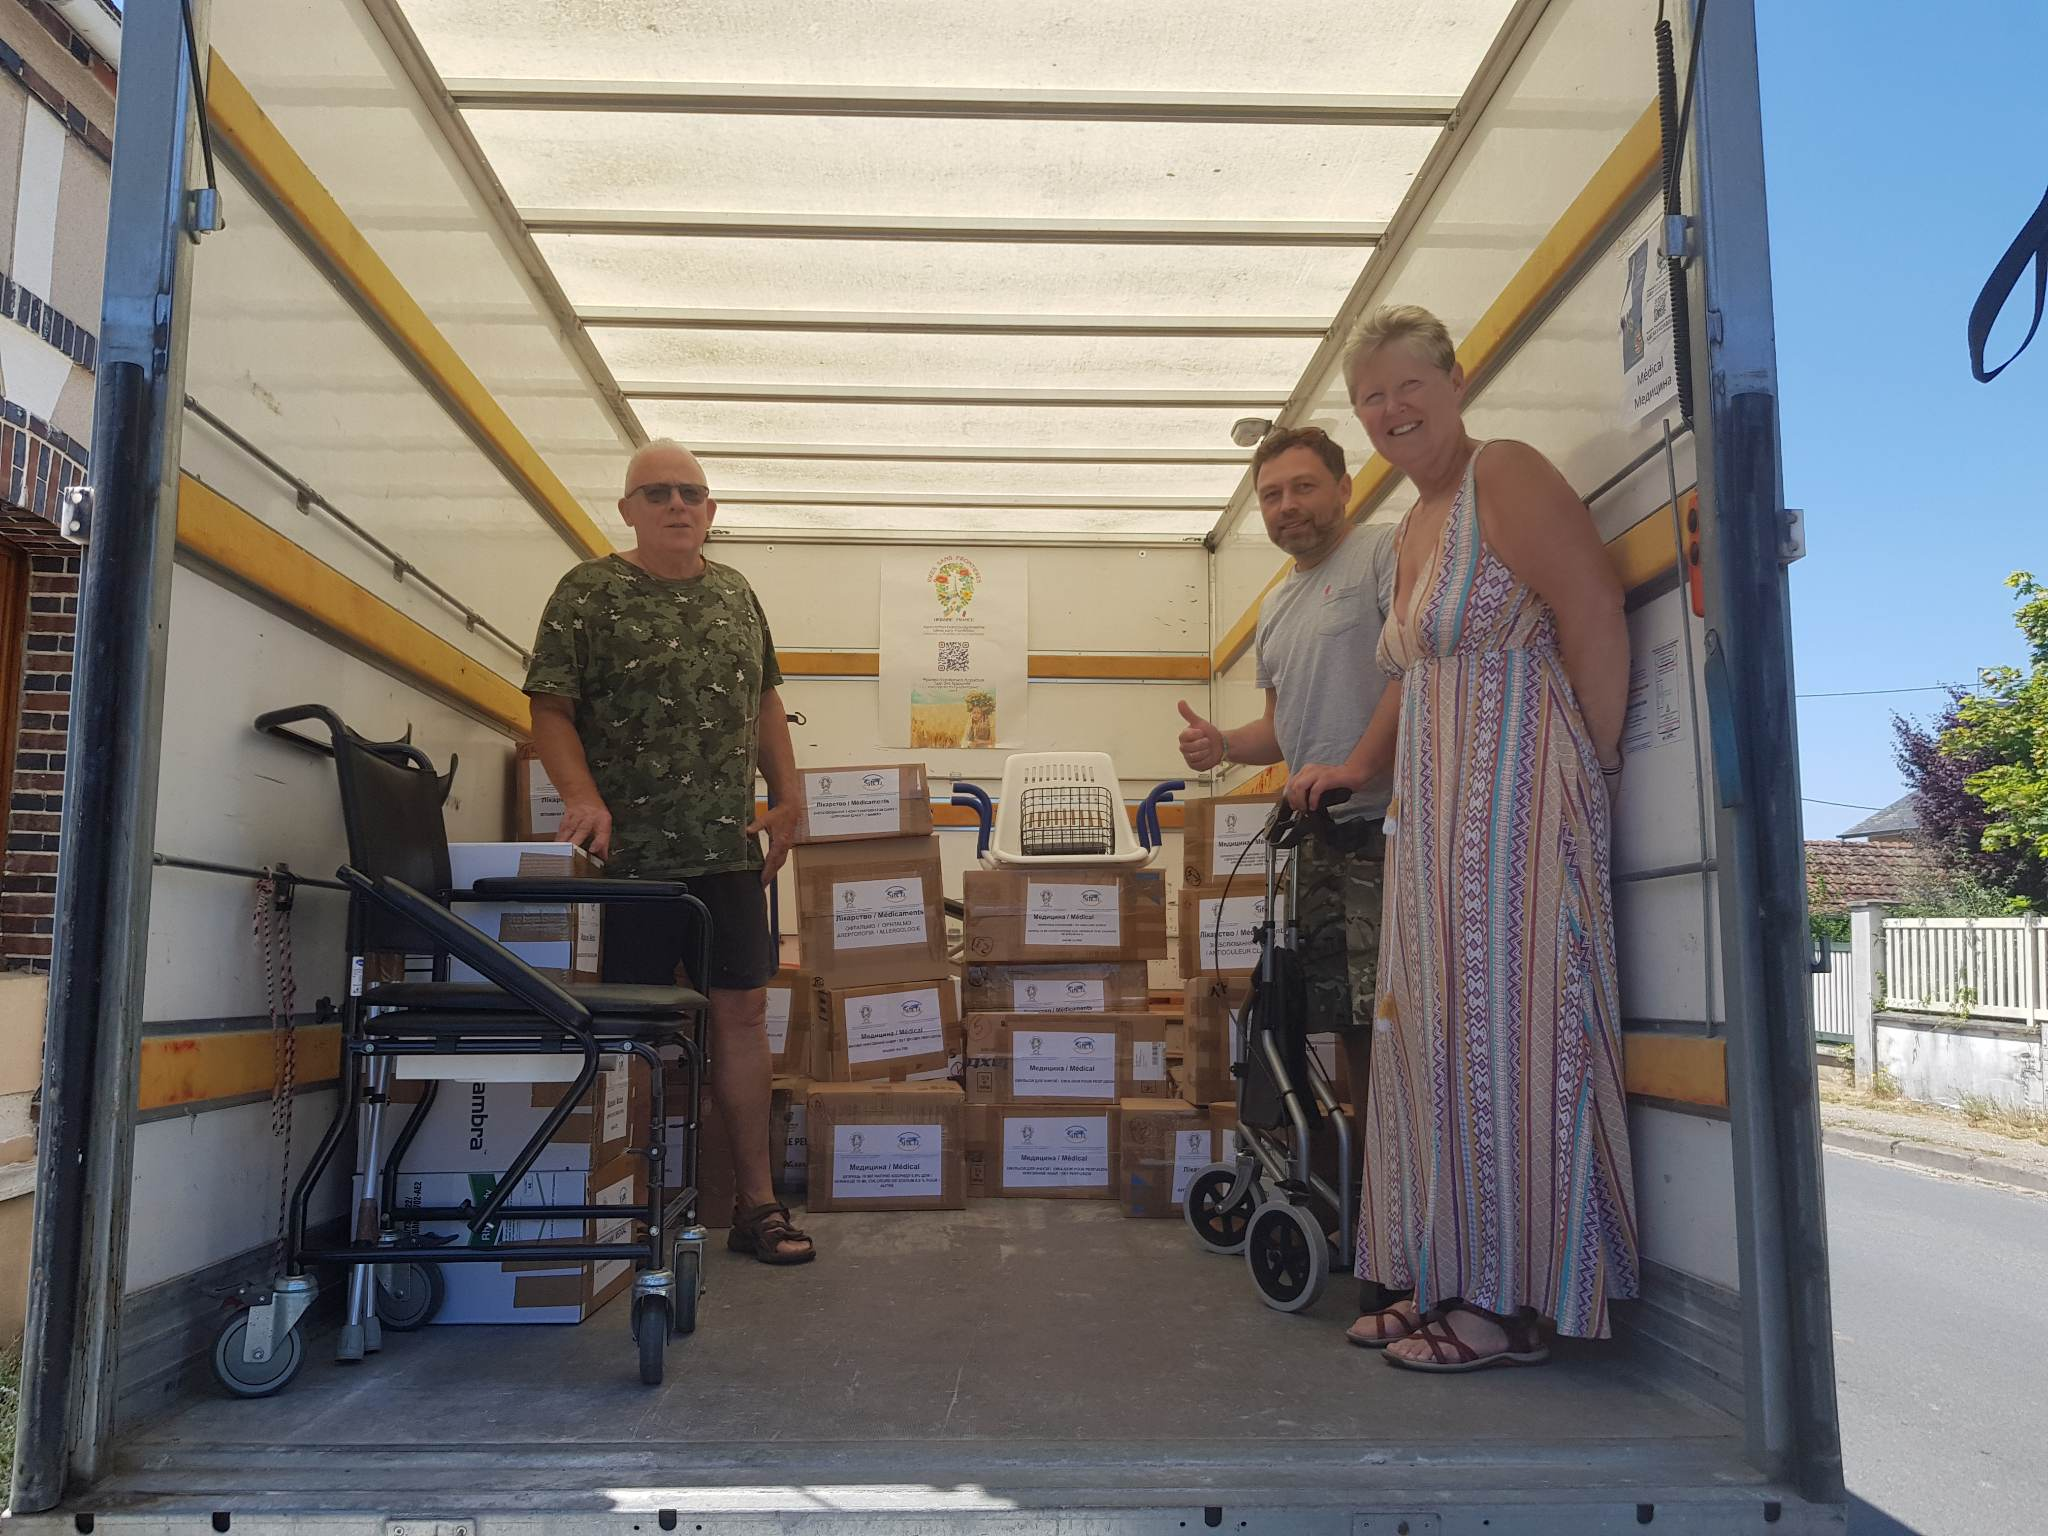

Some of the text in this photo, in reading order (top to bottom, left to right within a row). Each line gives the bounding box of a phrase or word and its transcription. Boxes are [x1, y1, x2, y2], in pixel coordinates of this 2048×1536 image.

[1637, 356, 1663, 386] Médical
[1634, 375, 1671, 409] Медицина
[878, 909, 923, 918] Médicaments
[849, 1163, 886, 1171] Медицина
